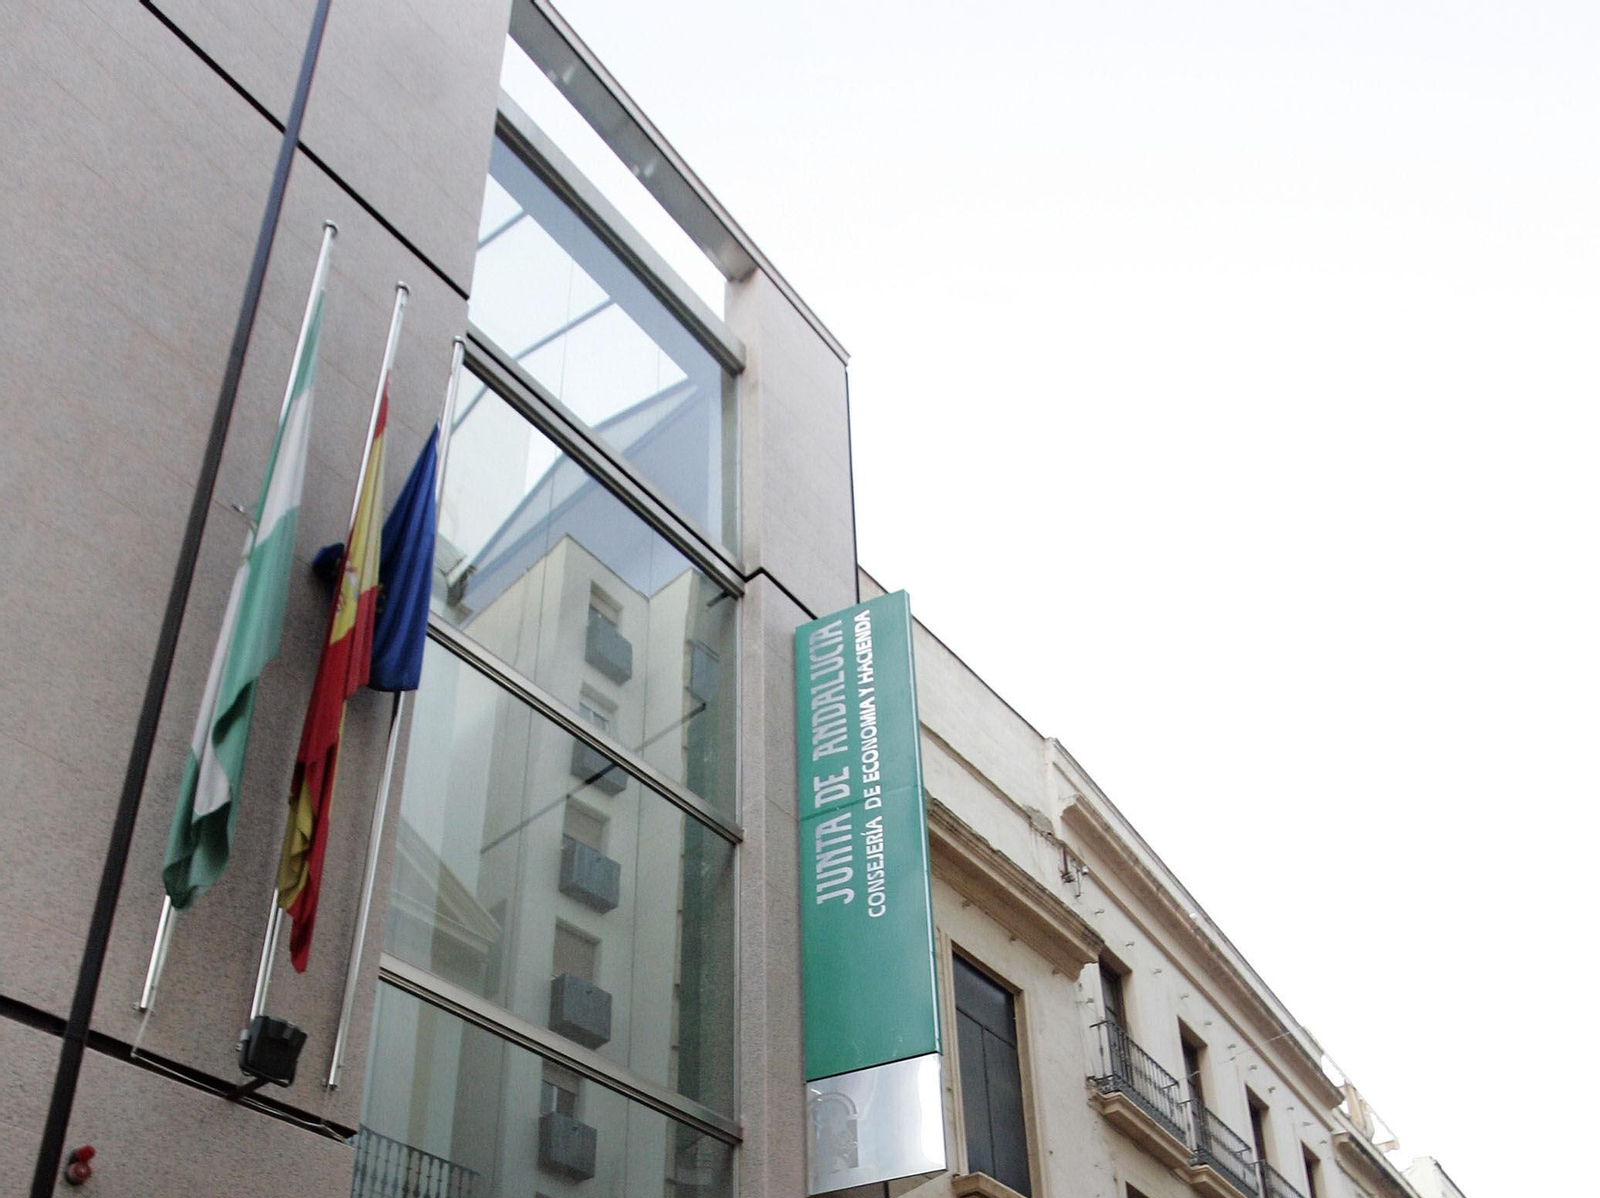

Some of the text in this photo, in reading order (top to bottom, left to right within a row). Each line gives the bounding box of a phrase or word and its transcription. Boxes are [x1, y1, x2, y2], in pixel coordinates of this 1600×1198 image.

[854, 610, 874, 685] HACIENDA
[858, 687, 875, 697] Y
[814, 766, 850, 808] DE
[864, 785, 882, 810] DE
[815, 812, 855, 904] JUNTA
[861, 816, 886, 918] CONSEJERÍA
